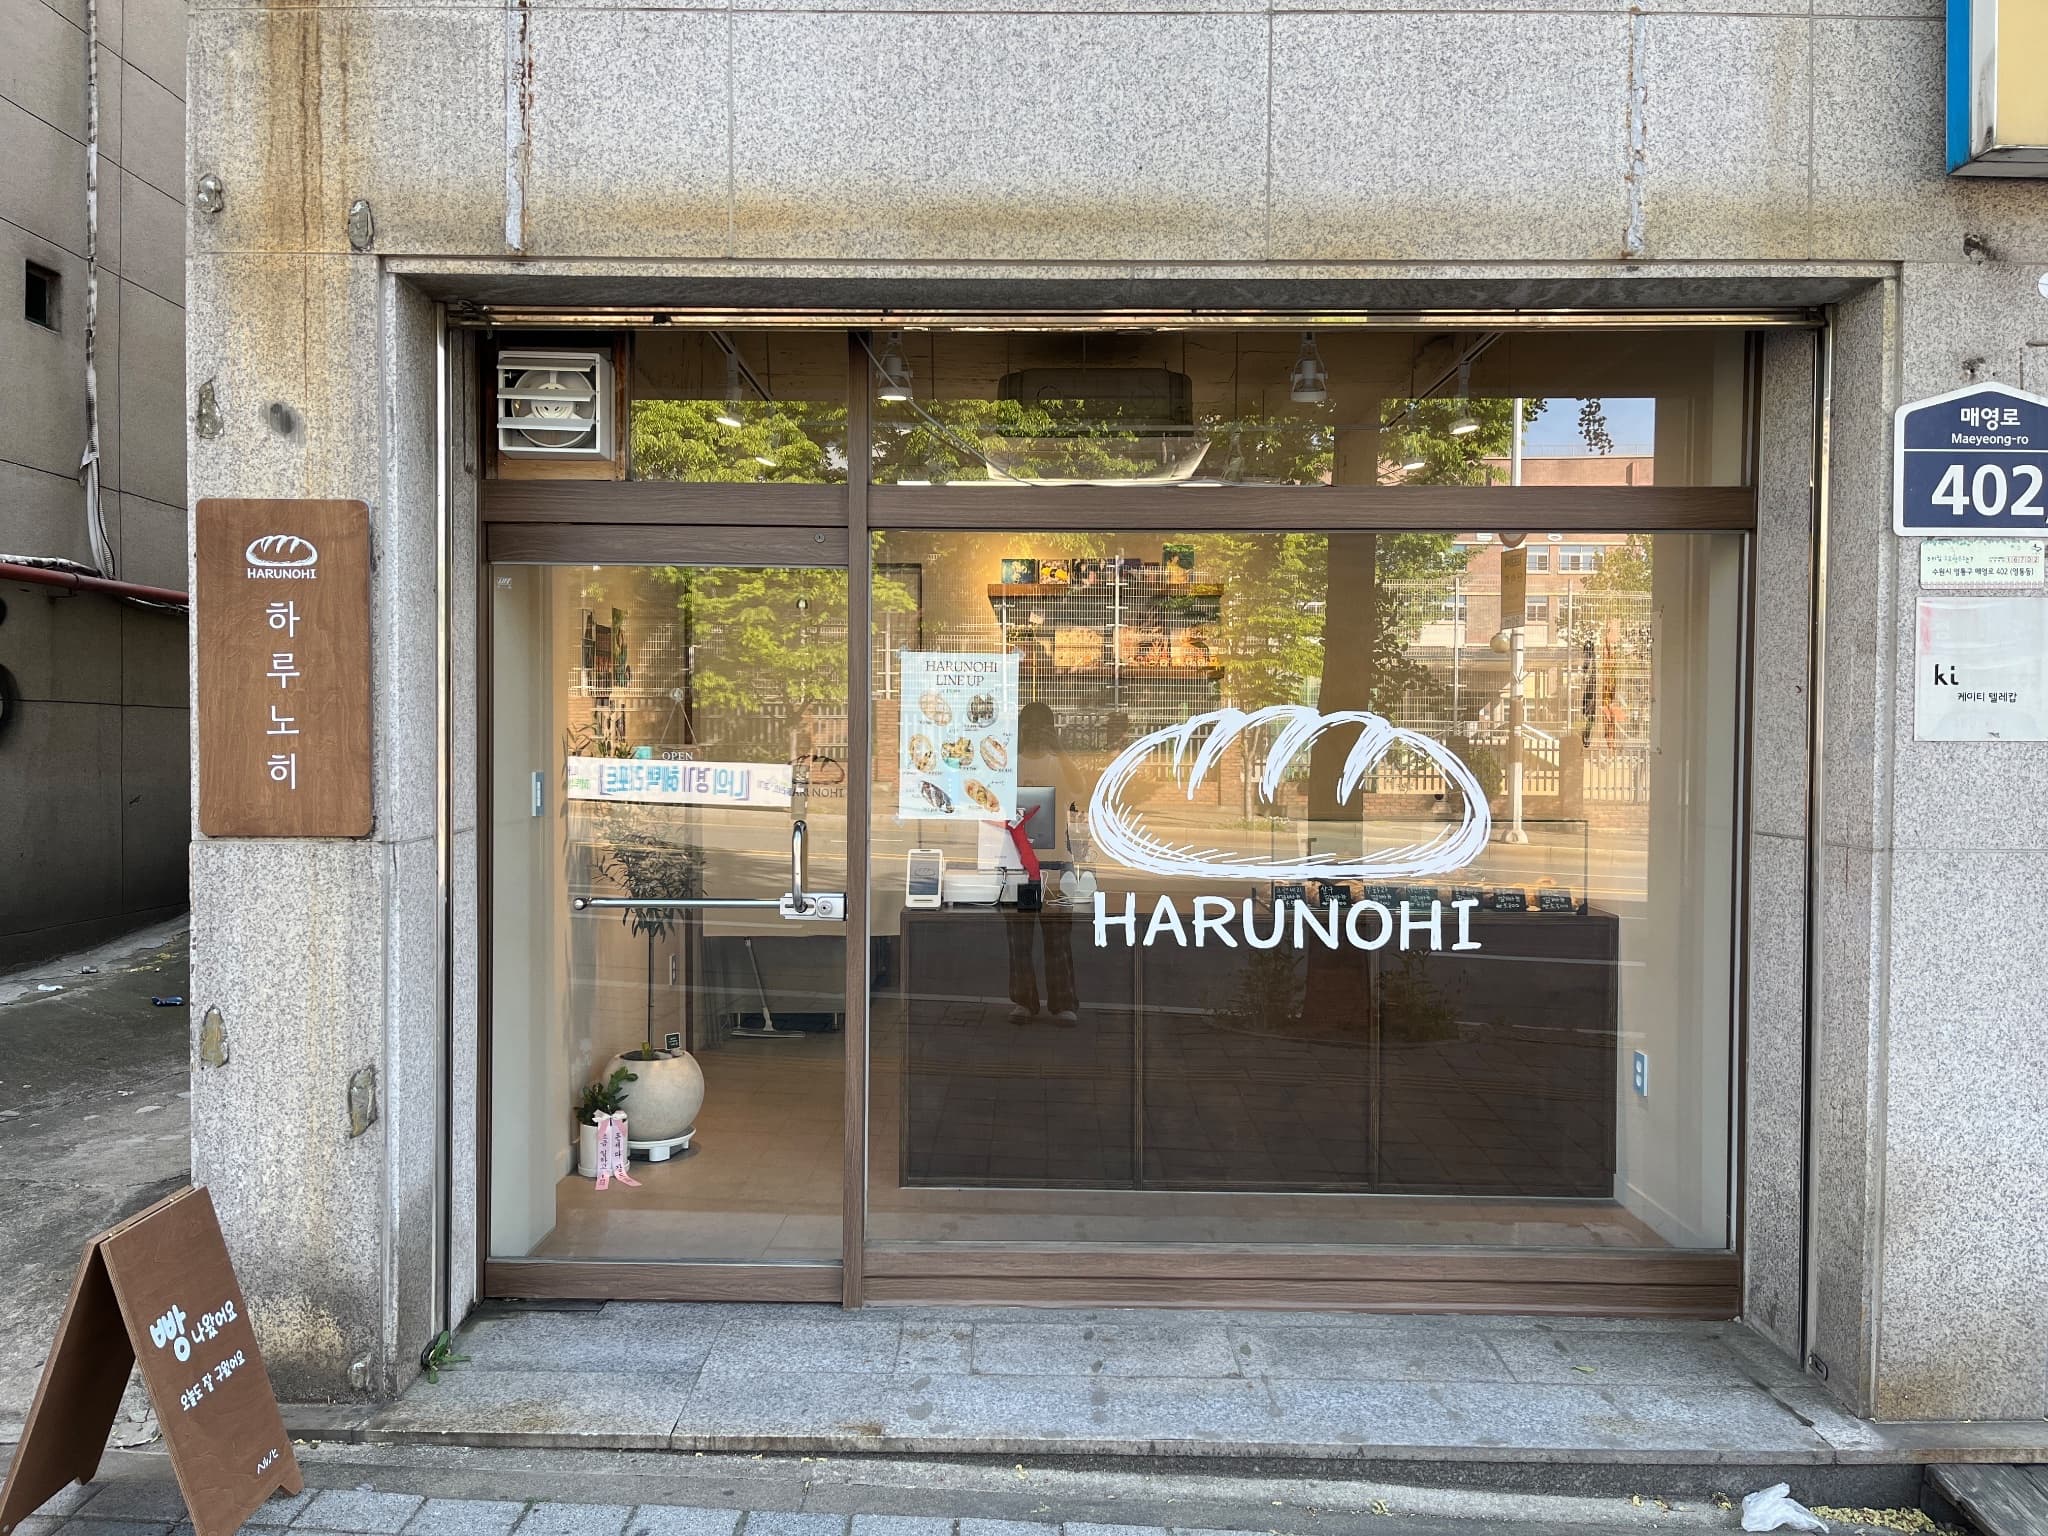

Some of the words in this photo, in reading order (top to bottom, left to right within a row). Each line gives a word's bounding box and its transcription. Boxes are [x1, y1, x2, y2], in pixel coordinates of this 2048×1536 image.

[1960, 407, 2021, 431] 매영로
[1951, 433, 2029, 447] Maeyeong-ro
[1931, 464, 2044, 517] 402
[247, 568, 317, 580] HARUNOHI
[926, 660, 998, 673] HARUNOHI
[936, 674, 965, 687] LINE
[967, 674, 985, 687] UP
[265, 600, 301, 790] 하루노히
[1957, 691, 1985, 702] 케이티
[1988, 691, 2017, 704] 텔레캅
[662, 751, 694, 761] OPEN
[1093, 891, 1482, 952] HARUNOHI
[150, 1304, 191, 1362] 빵
[191, 1300, 238, 1344] 나왔어요
[180, 1383, 203, 1412] 오늘도
[202, 1372, 214, 1393] 잘
